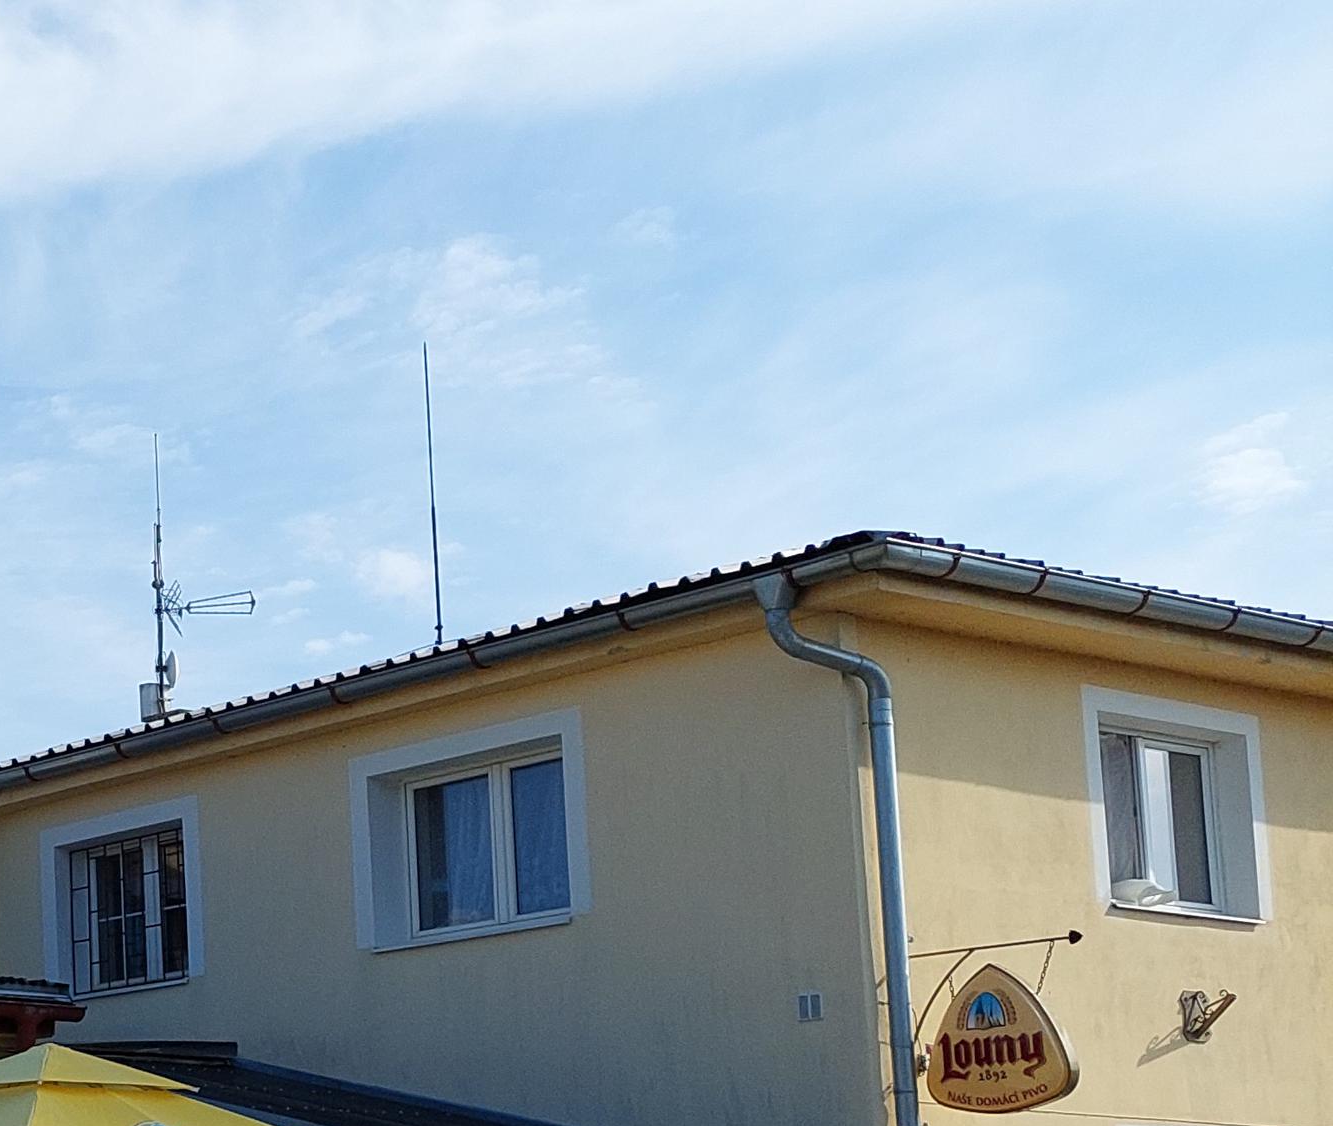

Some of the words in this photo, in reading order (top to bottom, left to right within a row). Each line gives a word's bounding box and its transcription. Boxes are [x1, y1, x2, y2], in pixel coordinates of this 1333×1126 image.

[939, 1030, 1047, 1084] Louny
[978, 1070, 1008, 1083] 1892
[948, 1091, 972, 1106] NAŠE
[976, 1091, 1020, 1106] DOMÁCÍ
[1021, 1083, 1048, 1101] PIVO
